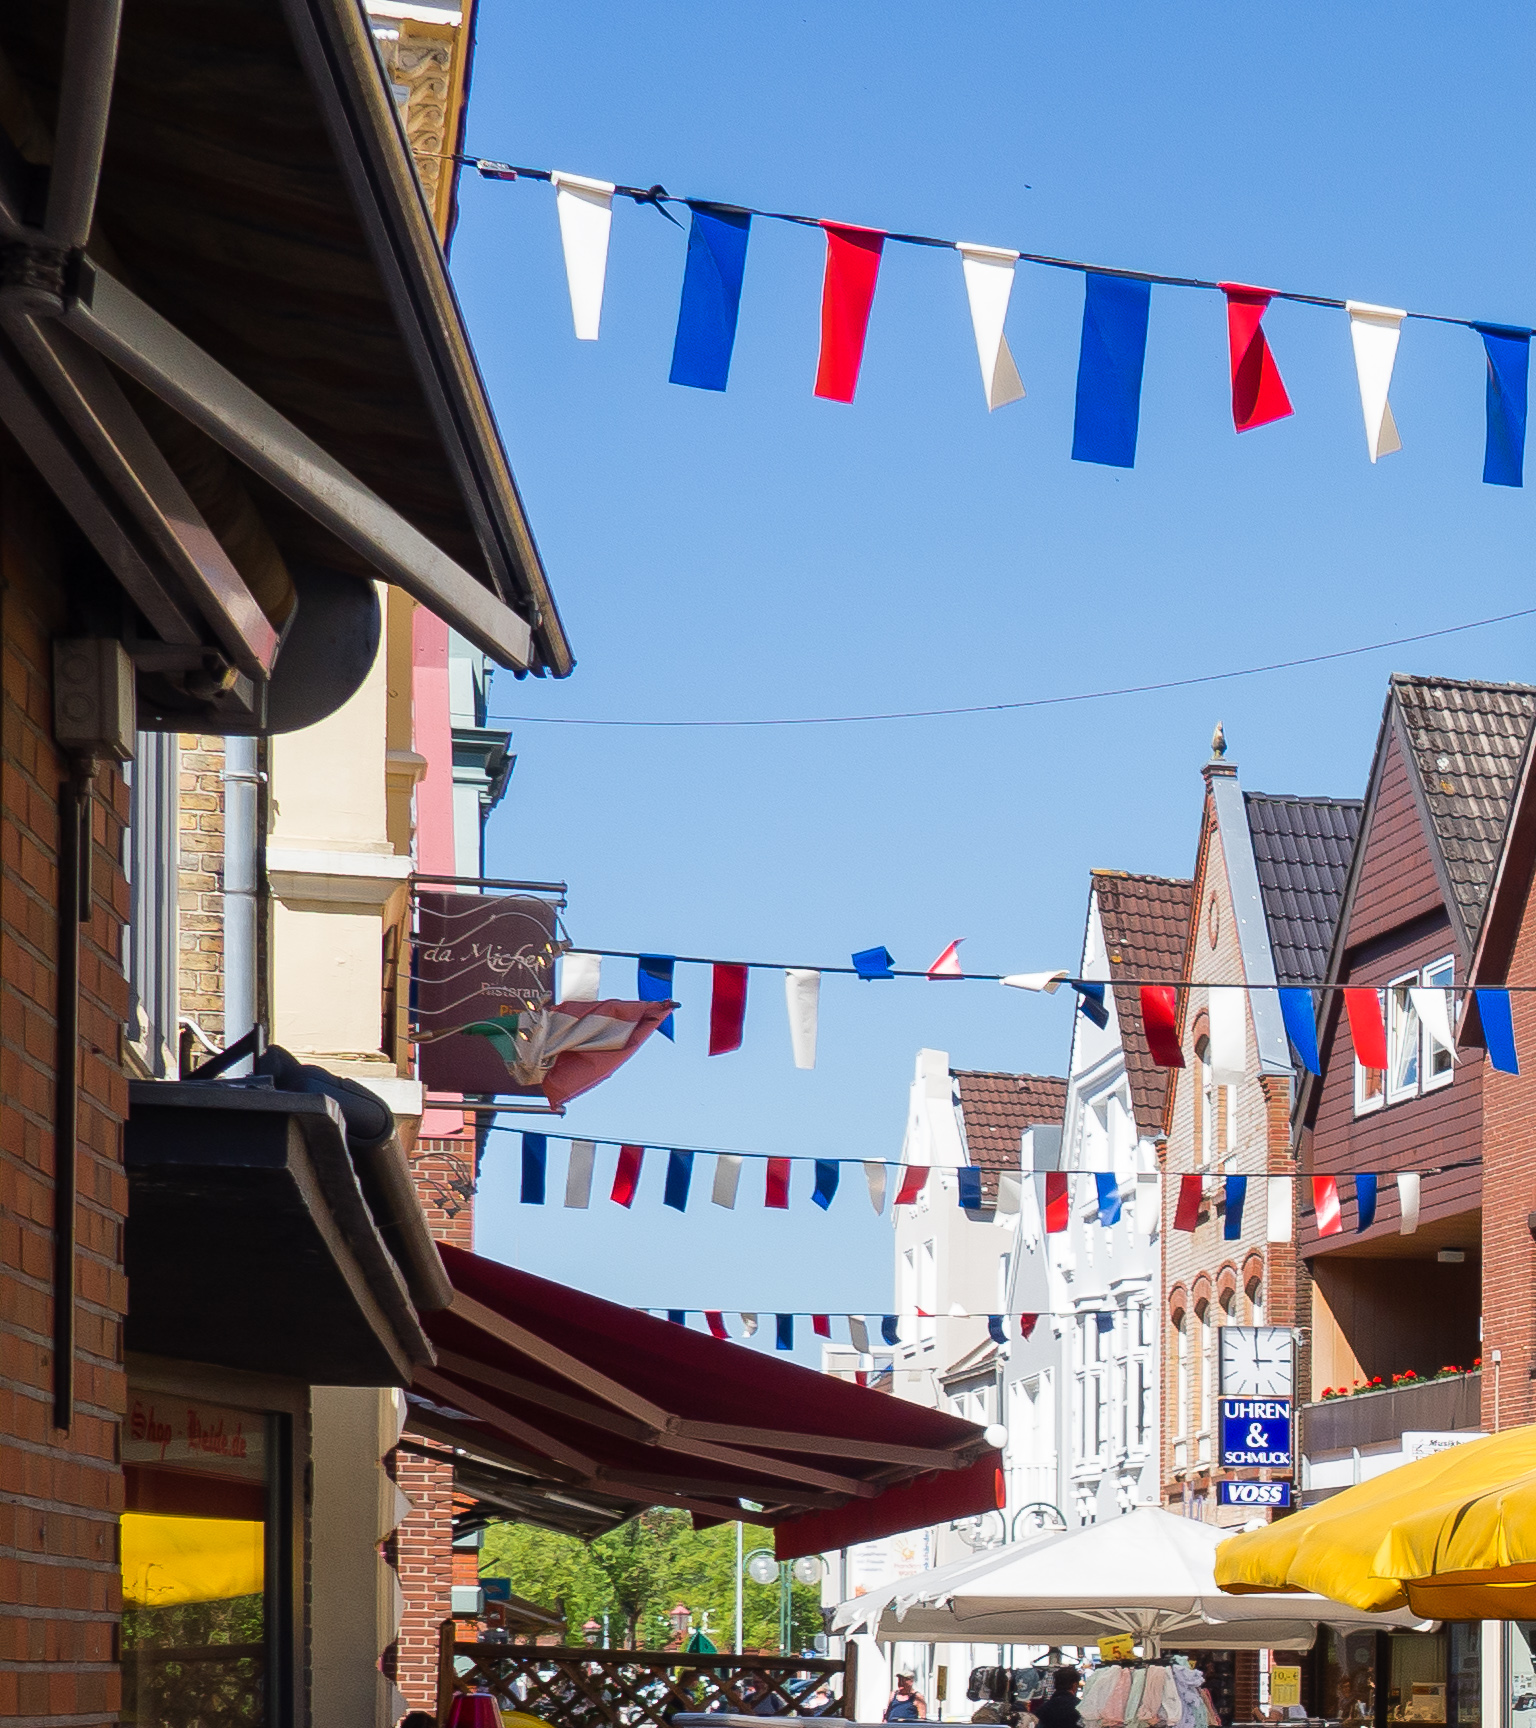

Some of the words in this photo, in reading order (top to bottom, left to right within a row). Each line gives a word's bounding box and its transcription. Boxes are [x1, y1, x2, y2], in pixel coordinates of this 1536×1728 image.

[423, 937, 455, 962] da
[1225, 1402, 1289, 1419] UHREN
[1246, 1422, 1268, 1447] &
[1225, 1451, 1289, 1464] SCHMUCK
[1228, 1485, 1282, 1503] VOSS
